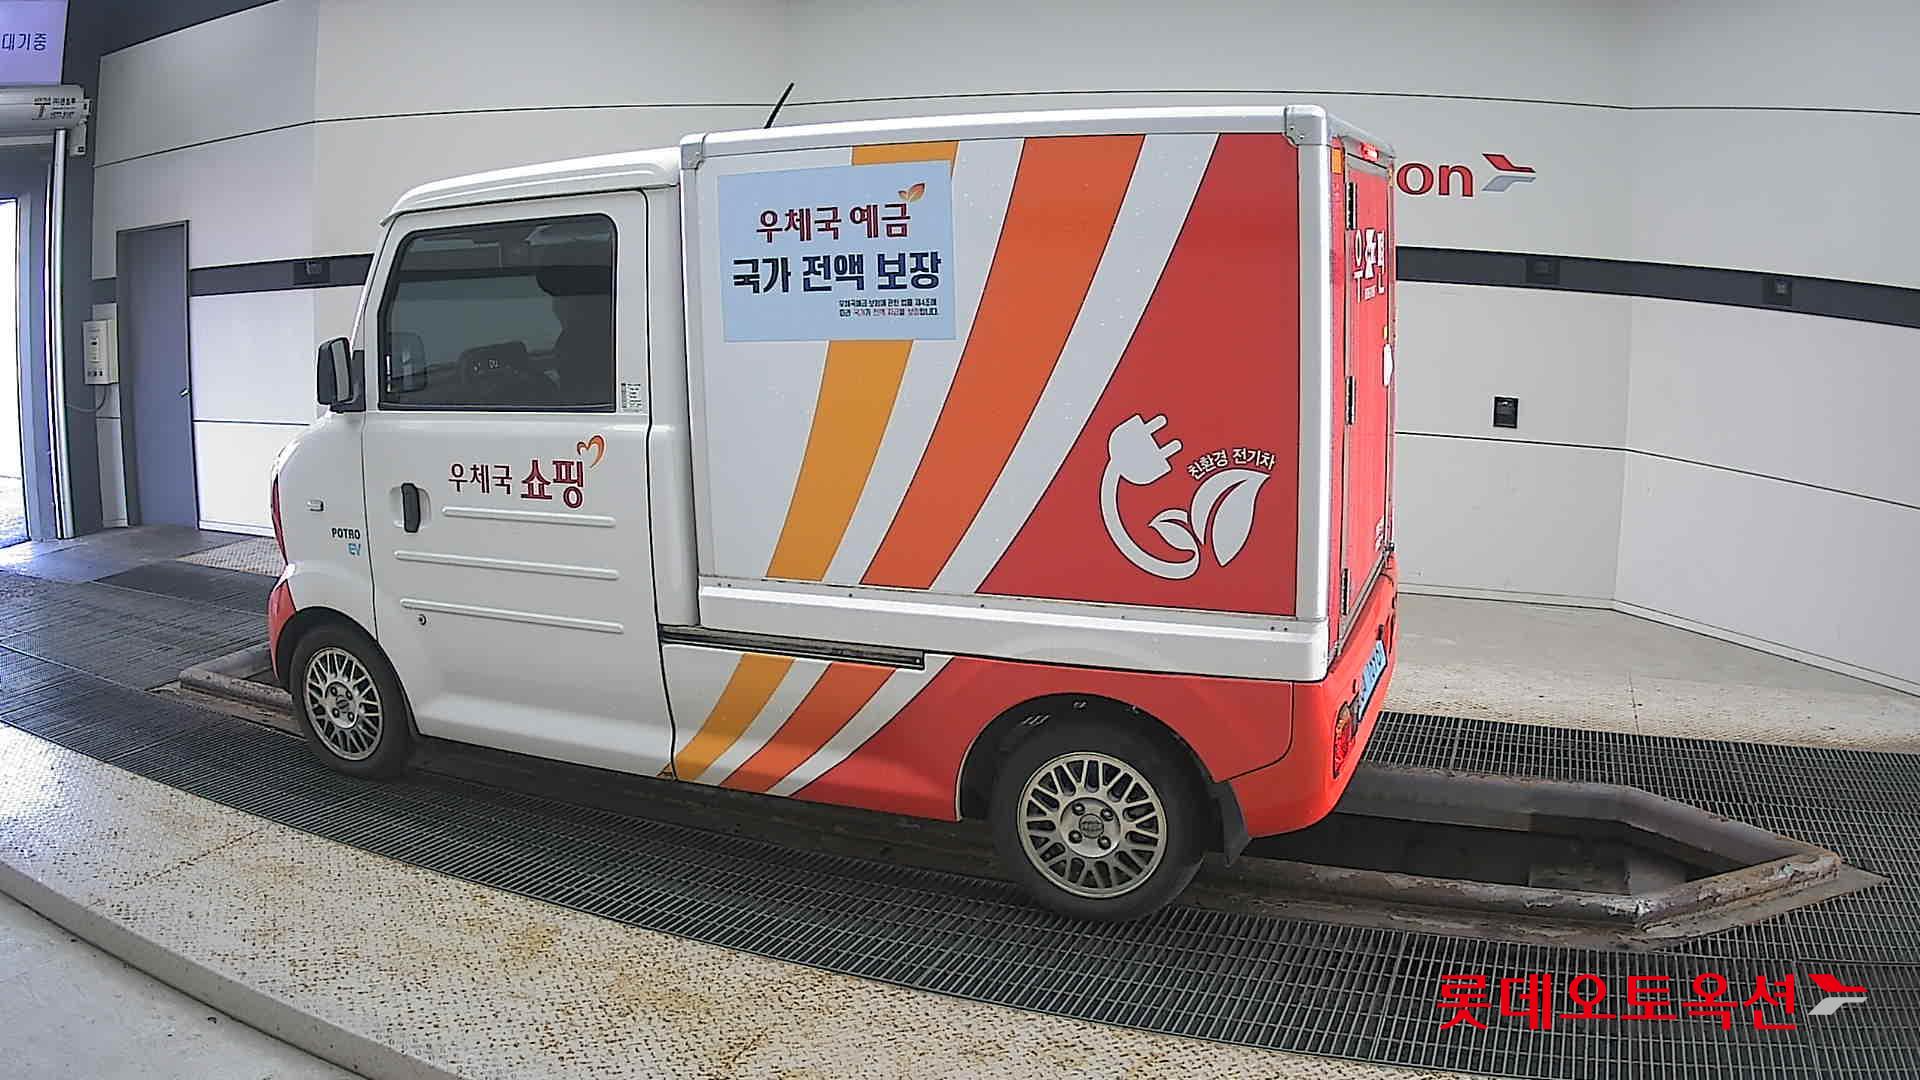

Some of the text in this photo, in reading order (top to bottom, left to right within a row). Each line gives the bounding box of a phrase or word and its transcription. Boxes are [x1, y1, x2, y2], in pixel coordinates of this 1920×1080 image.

[2, 33, 47, 51] 대기중
[756, 203, 911, 243] 우체국 예금
[733, 251, 942, 294] 국가 전액 보장
[1188, 448, 1275, 480] 친환경 전기차
[448, 459, 585, 509] 우체국 쇼핑
[331, 527, 361, 540] POTRO
